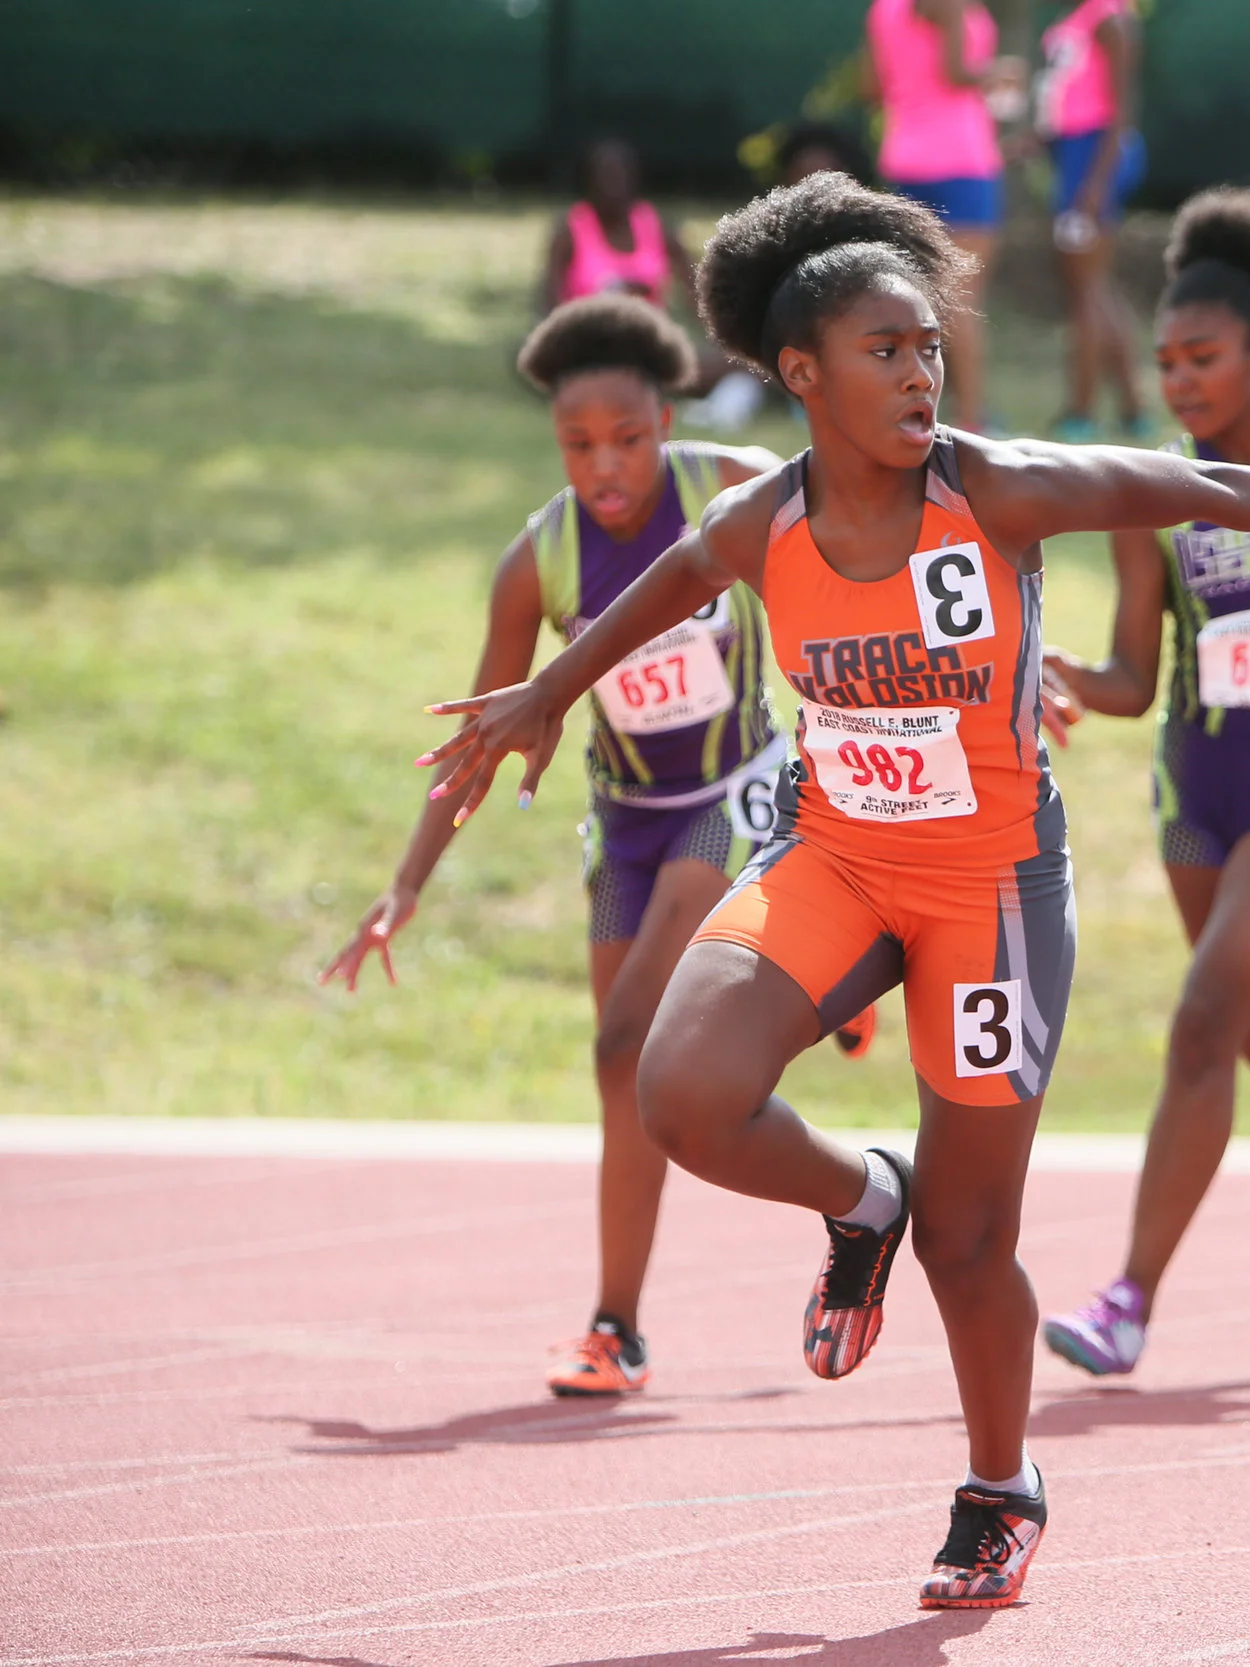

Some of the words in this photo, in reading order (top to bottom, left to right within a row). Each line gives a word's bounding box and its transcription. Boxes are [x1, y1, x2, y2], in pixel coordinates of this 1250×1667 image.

[619, 656, 686, 708] 657
[817, 716, 841, 730] EAST
[842, 723, 873, 734] COAST
[841, 713, 885, 728] RUSSELL
[902, 715, 939, 728] BLUNT
[838, 740, 932, 794] 982
[933, 790, 961, 798] BROOKS
[741, 780, 774, 831] 6
[861, 803, 897, 815] ACTIVE
[881, 799, 921, 809] STREET
[963, 988, 1012, 1069] 3
